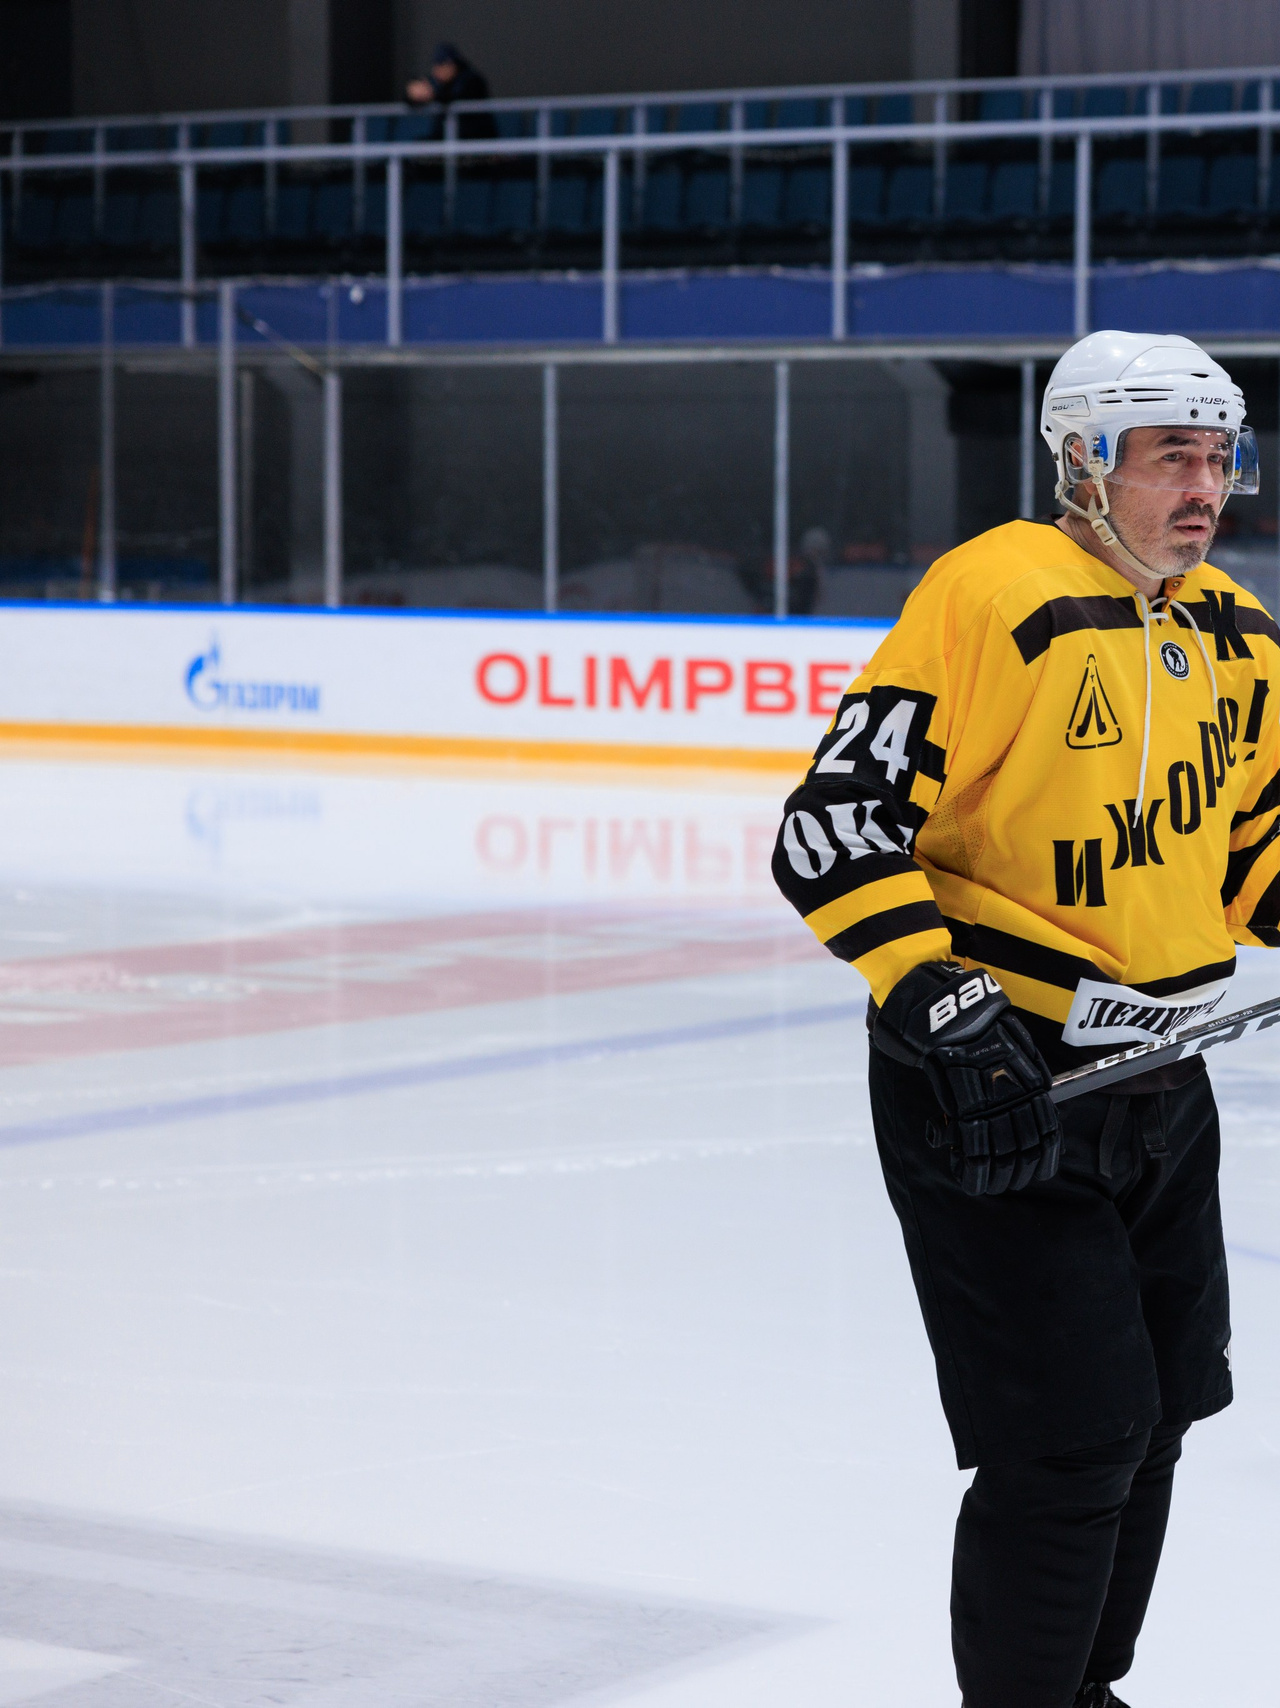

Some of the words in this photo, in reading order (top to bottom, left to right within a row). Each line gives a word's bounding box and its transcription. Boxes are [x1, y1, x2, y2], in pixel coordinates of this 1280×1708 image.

[475, 652, 870, 717] OLIMPBE
[815, 699, 918, 785] 24
[1215, 1018, 1229, 1026] FLEX
